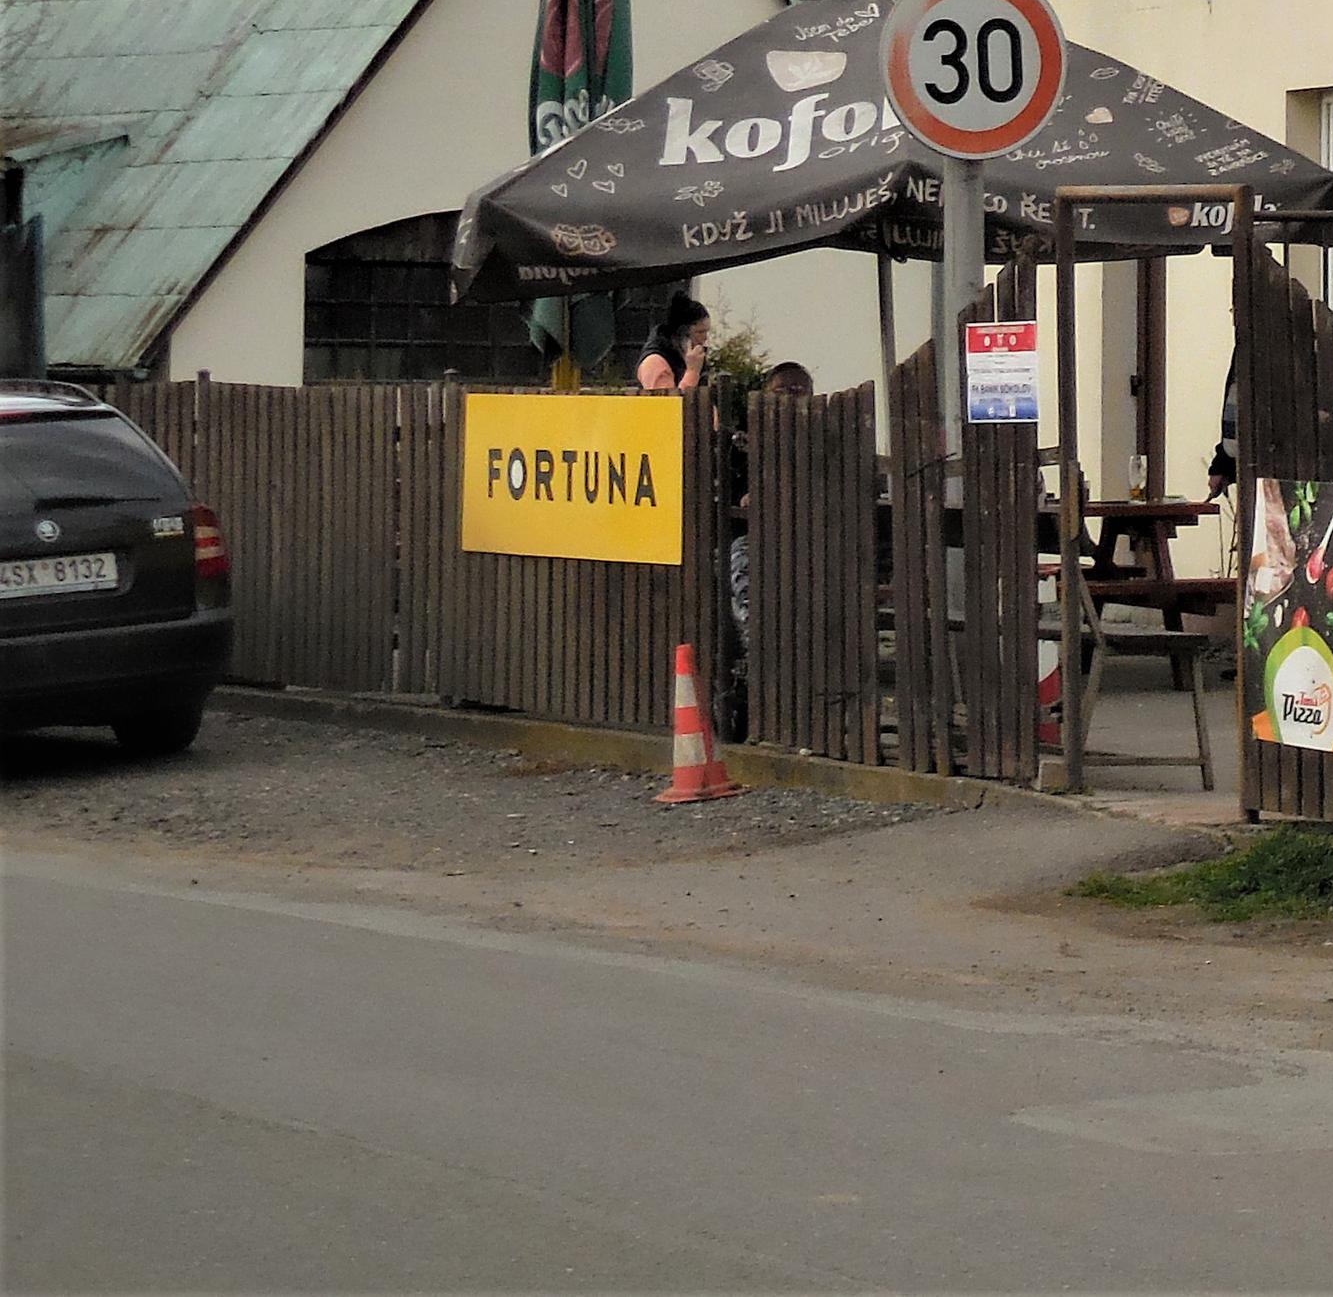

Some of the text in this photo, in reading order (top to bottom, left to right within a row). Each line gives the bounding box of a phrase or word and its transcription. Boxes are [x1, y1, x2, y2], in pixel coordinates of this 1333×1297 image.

[923, 18, 1023, 104] 30
[659, 93, 901, 172] kofo
[682, 211, 753, 249] KDYŽ
[765, 217, 784, 235] JI
[797, 172, 897, 228] MILUJEŠ,
[907, 176, 944, 207] NE
[487, 447, 657, 507] FORTUNA
[54, 558, 107, 582] 8132
[1282, 693, 1324, 725] Pizza
